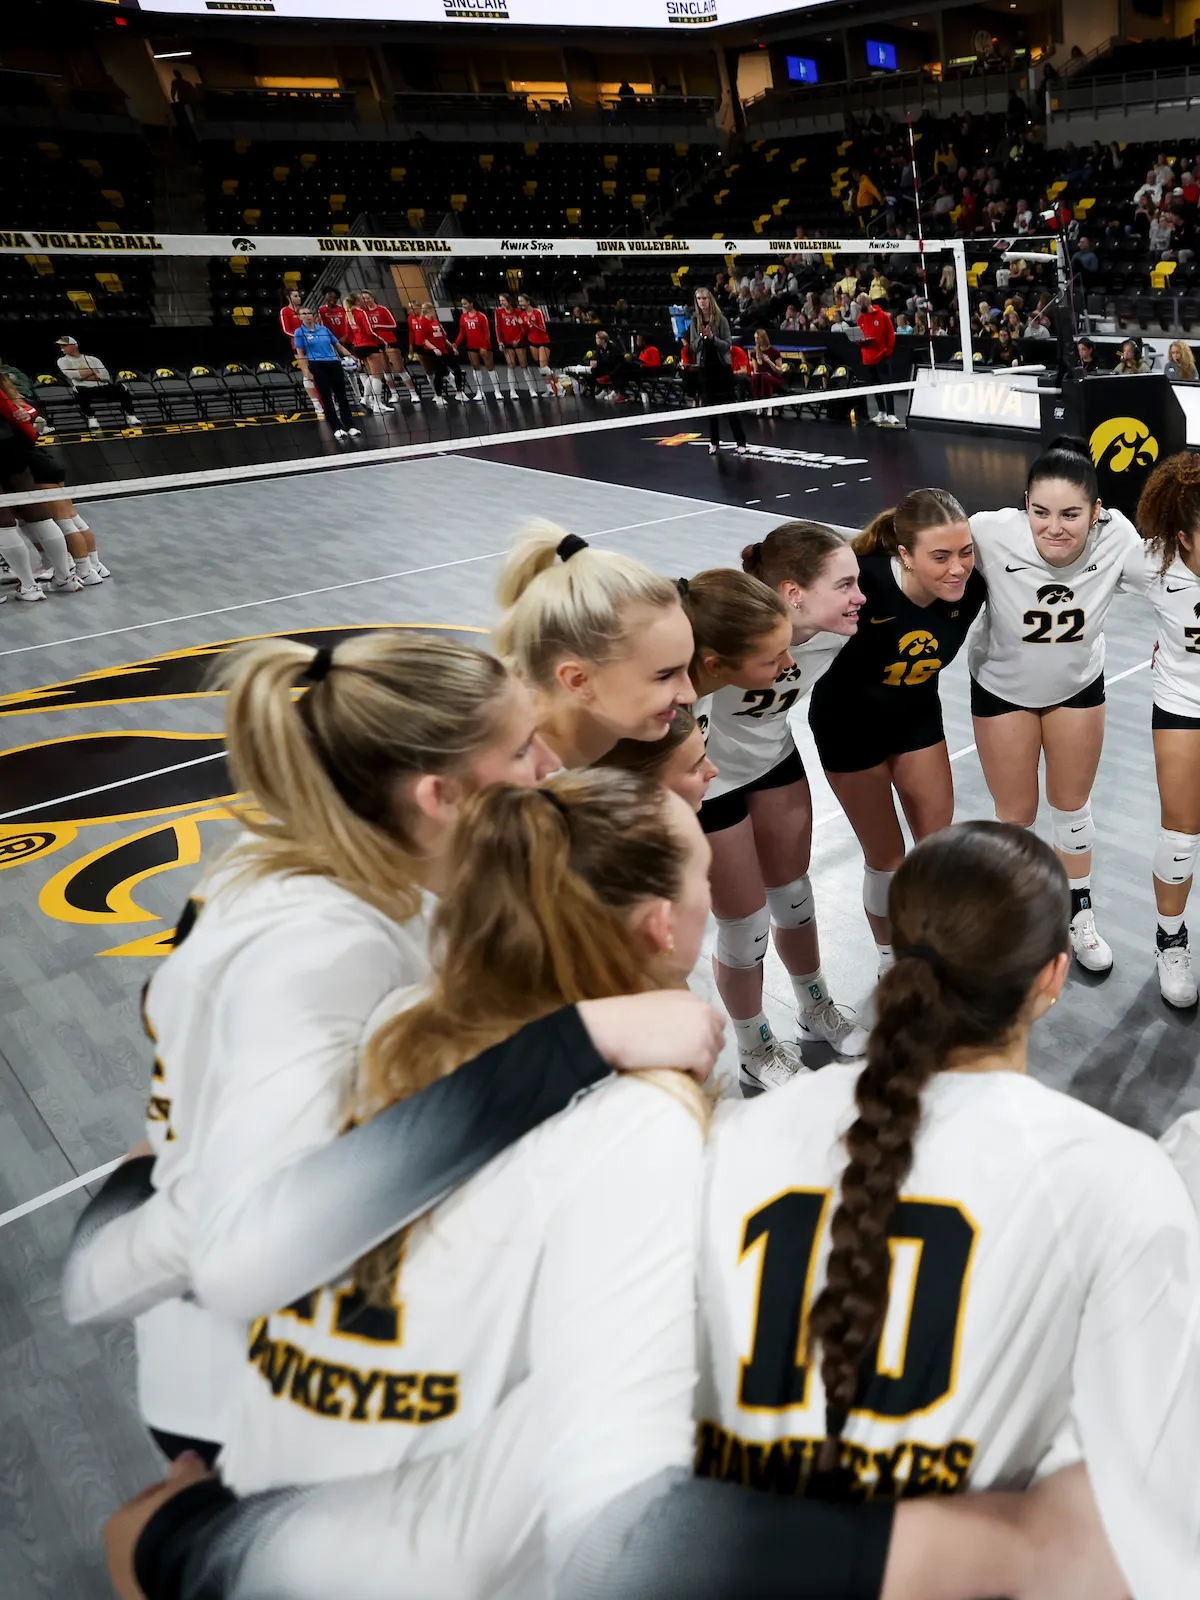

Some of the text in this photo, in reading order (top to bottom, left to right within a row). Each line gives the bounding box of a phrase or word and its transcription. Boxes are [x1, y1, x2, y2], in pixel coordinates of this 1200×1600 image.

[666, 1, 717, 14] SINCLAIR
[32, 233, 163, 250] VOLLEYBALL
[318, 238, 452, 252] IOWA VOLLEYBALL
[597, 240, 690, 251] IOWA VOLLEYBALL
[769, 241, 841, 250] IOWA VOLLEYBALL
[942, 381, 1023, 418] IOWA
[1021, 608, 1086, 644] 22
[882, 658, 942, 686] 16
[733, 688, 800, 719] 21
[735, 1185, 977, 1424] 10
